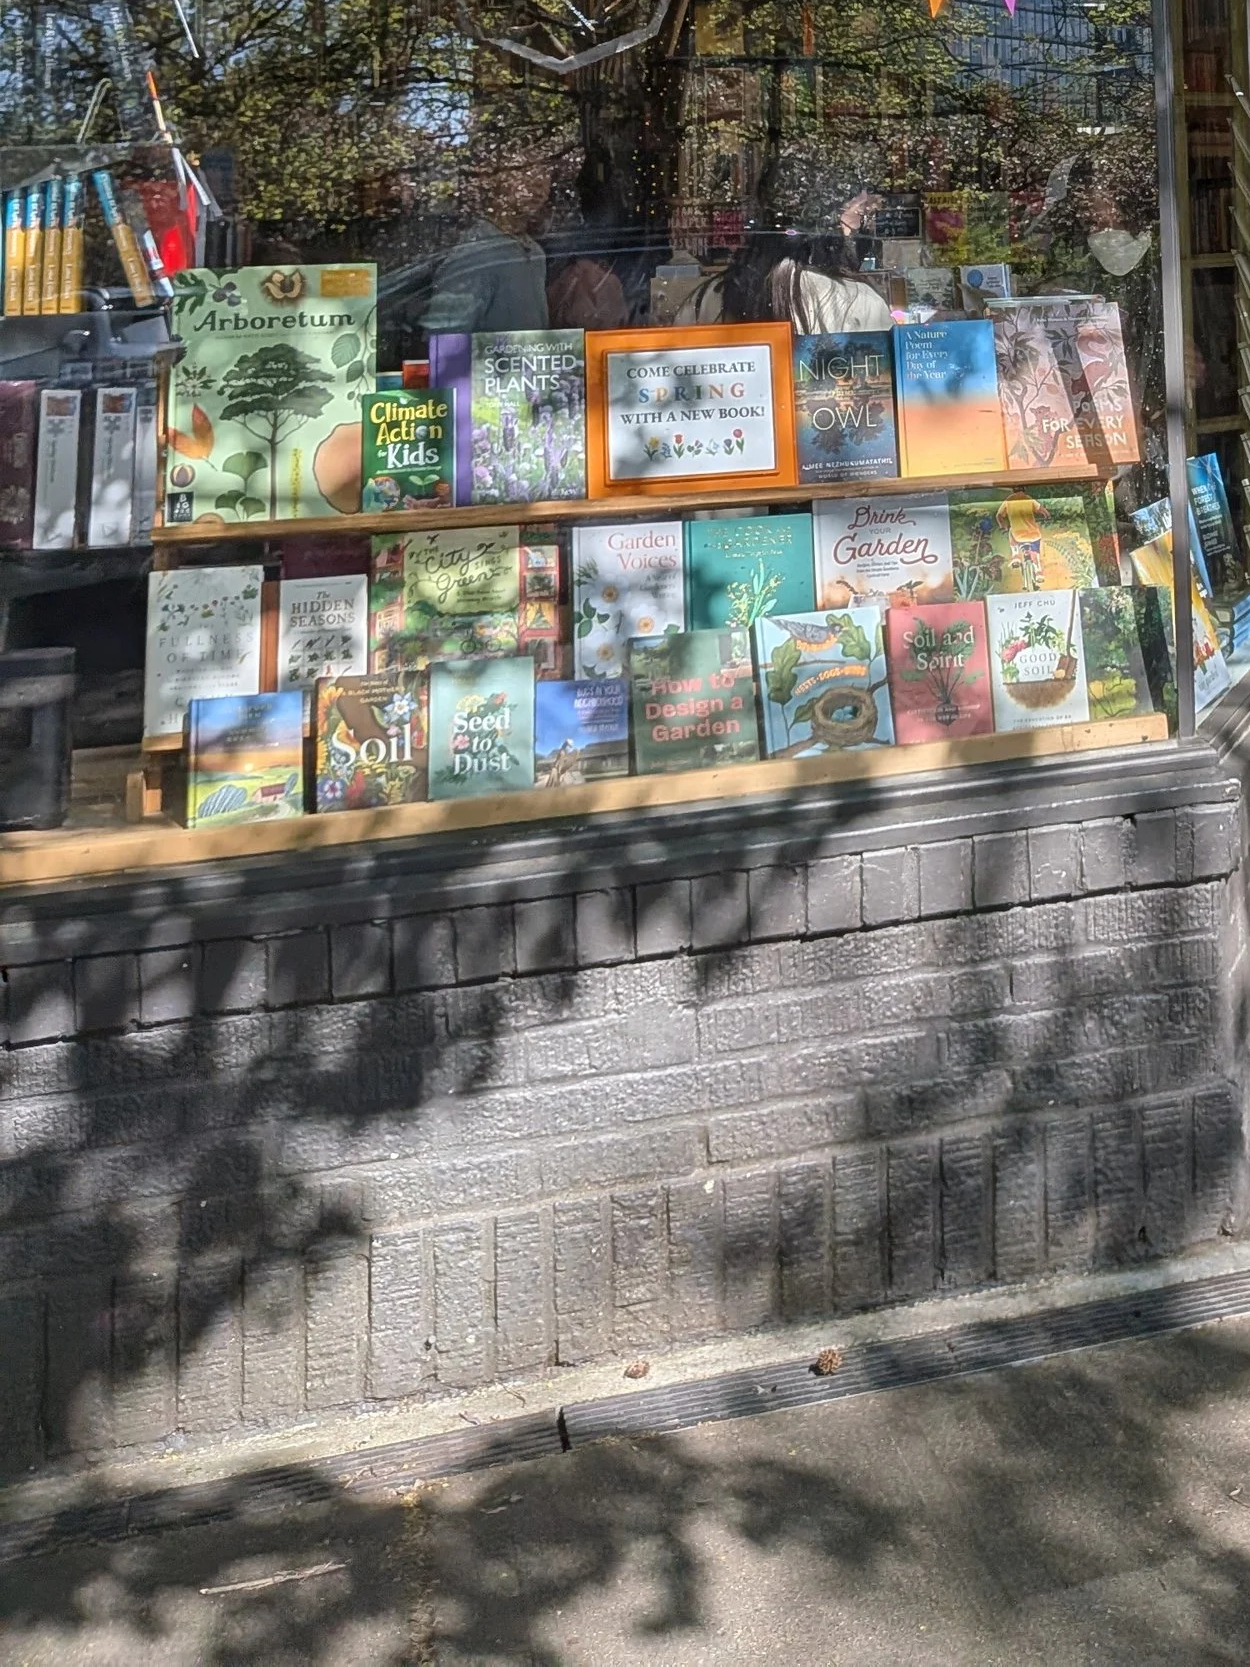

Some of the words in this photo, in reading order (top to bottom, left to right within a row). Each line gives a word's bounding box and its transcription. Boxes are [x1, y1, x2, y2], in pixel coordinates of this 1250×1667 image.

[194, 310, 355, 332] Arboretum
[914, 330, 947, 339] Nature
[485, 344, 544, 354] GARDENING
[546, 342, 573, 352] WITH
[906, 341, 933, 349] Poem
[906, 351, 919, 360] for
[922, 349, 948, 360] Every
[484, 354, 577, 375] SCENTED
[626, 366, 669, 379] COME
[672, 361, 756, 377] CELEBRATE
[799, 354, 884, 381] NIGHT
[906, 361, 926, 371] Day
[928, 360, 937, 368] of
[484, 374, 561, 394] PLANTS
[906, 371, 922, 379] the
[924, 371, 947, 379] Year
[638, 382, 745, 404] SPRING
[370, 399, 448, 424] Climate
[621, 412, 662, 425] WITH
[666, 410, 677, 422] A
[680, 408, 716, 421] NEW
[719, 405, 765, 419] BOOK!
[1073, 399, 1123, 412] POEMS
[812, 403, 877, 431] OWL
[1043, 418, 1069, 432] FOR
[1076, 415, 1124, 430] EVERY
[1066, 433, 1128, 449] SEASON
[386, 441, 440, 469] Kids
[848, 506, 916, 530] Drink
[608, 530, 676, 551] Garden
[833, 533, 939, 565] Garden
[425, 546, 480, 576] City
[616, 551, 677, 571] Voices
[317, 590, 332, 600] The
[436, 571, 500, 605] Green
[291, 597, 355, 614] HIDDEN
[1014, 601, 1033, 609] JEFF
[1037, 599, 1056, 607] CHU
[290, 612, 356, 628] SEASONS
[159, 634, 254, 648] FULLNESS
[902, 629, 936, 649] Soil
[943, 625, 975, 645] and
[166, 652, 188, 664] OF
[200, 649, 242, 662] TIME
[916, 650, 966, 672] Spirit
[1019, 652, 1057, 664] GOOD
[1023, 665, 1053, 677] SOIL
[650, 674, 702, 695] How
[709, 671, 736, 689] to
[645, 696, 723, 720] Design
[730, 696, 744, 710] a
[453, 710, 511, 733] Seed
[652, 716, 740, 743] Garden
[332, 722, 412, 767] Soil
[472, 737, 492, 753] to
[454, 752, 511, 775] Dust
